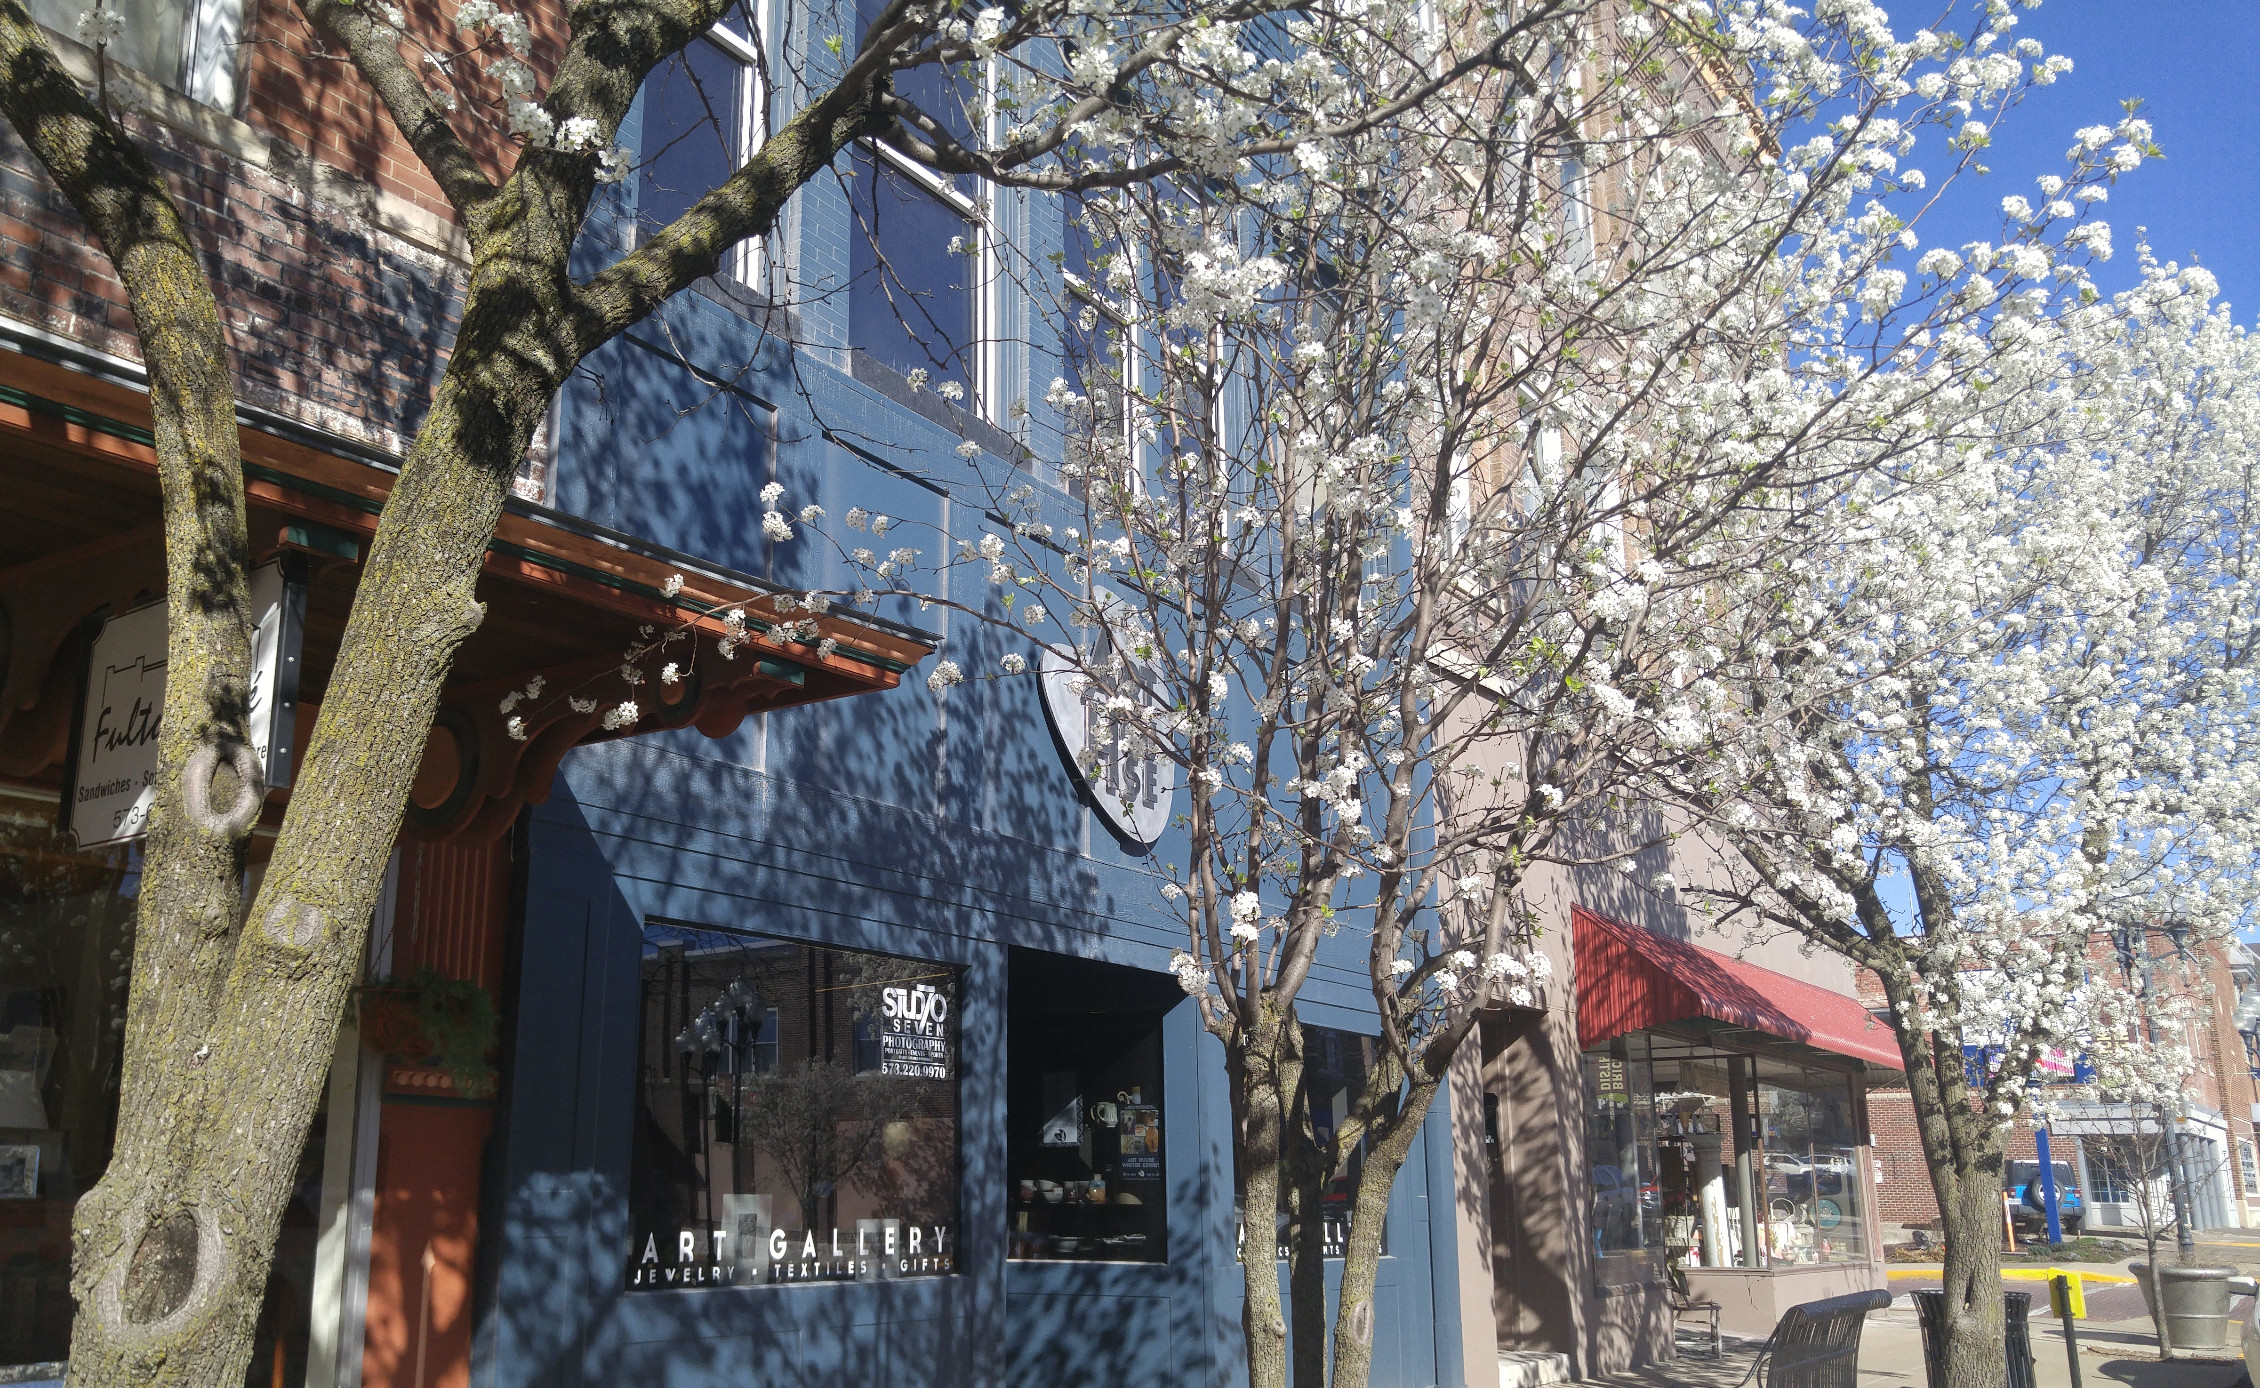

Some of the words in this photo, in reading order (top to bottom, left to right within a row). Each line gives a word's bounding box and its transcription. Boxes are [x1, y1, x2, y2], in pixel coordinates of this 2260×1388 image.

[78, 777, 131, 803] Sandwiches
[893, 1019, 944, 1036] SEVEN
[883, 1036, 945, 1051] PHOTOGRAPHY
[882, 1063, 945, 1078] 573.220.9970
[641, 1231, 727, 1264] ART
[769, 1226, 947, 1260] GALLERY
[633, 1265, 735, 1285] JEWELRY
[774, 1261, 867, 1278] TEXTILES
[900, 1257, 950, 1272] GIFTS
